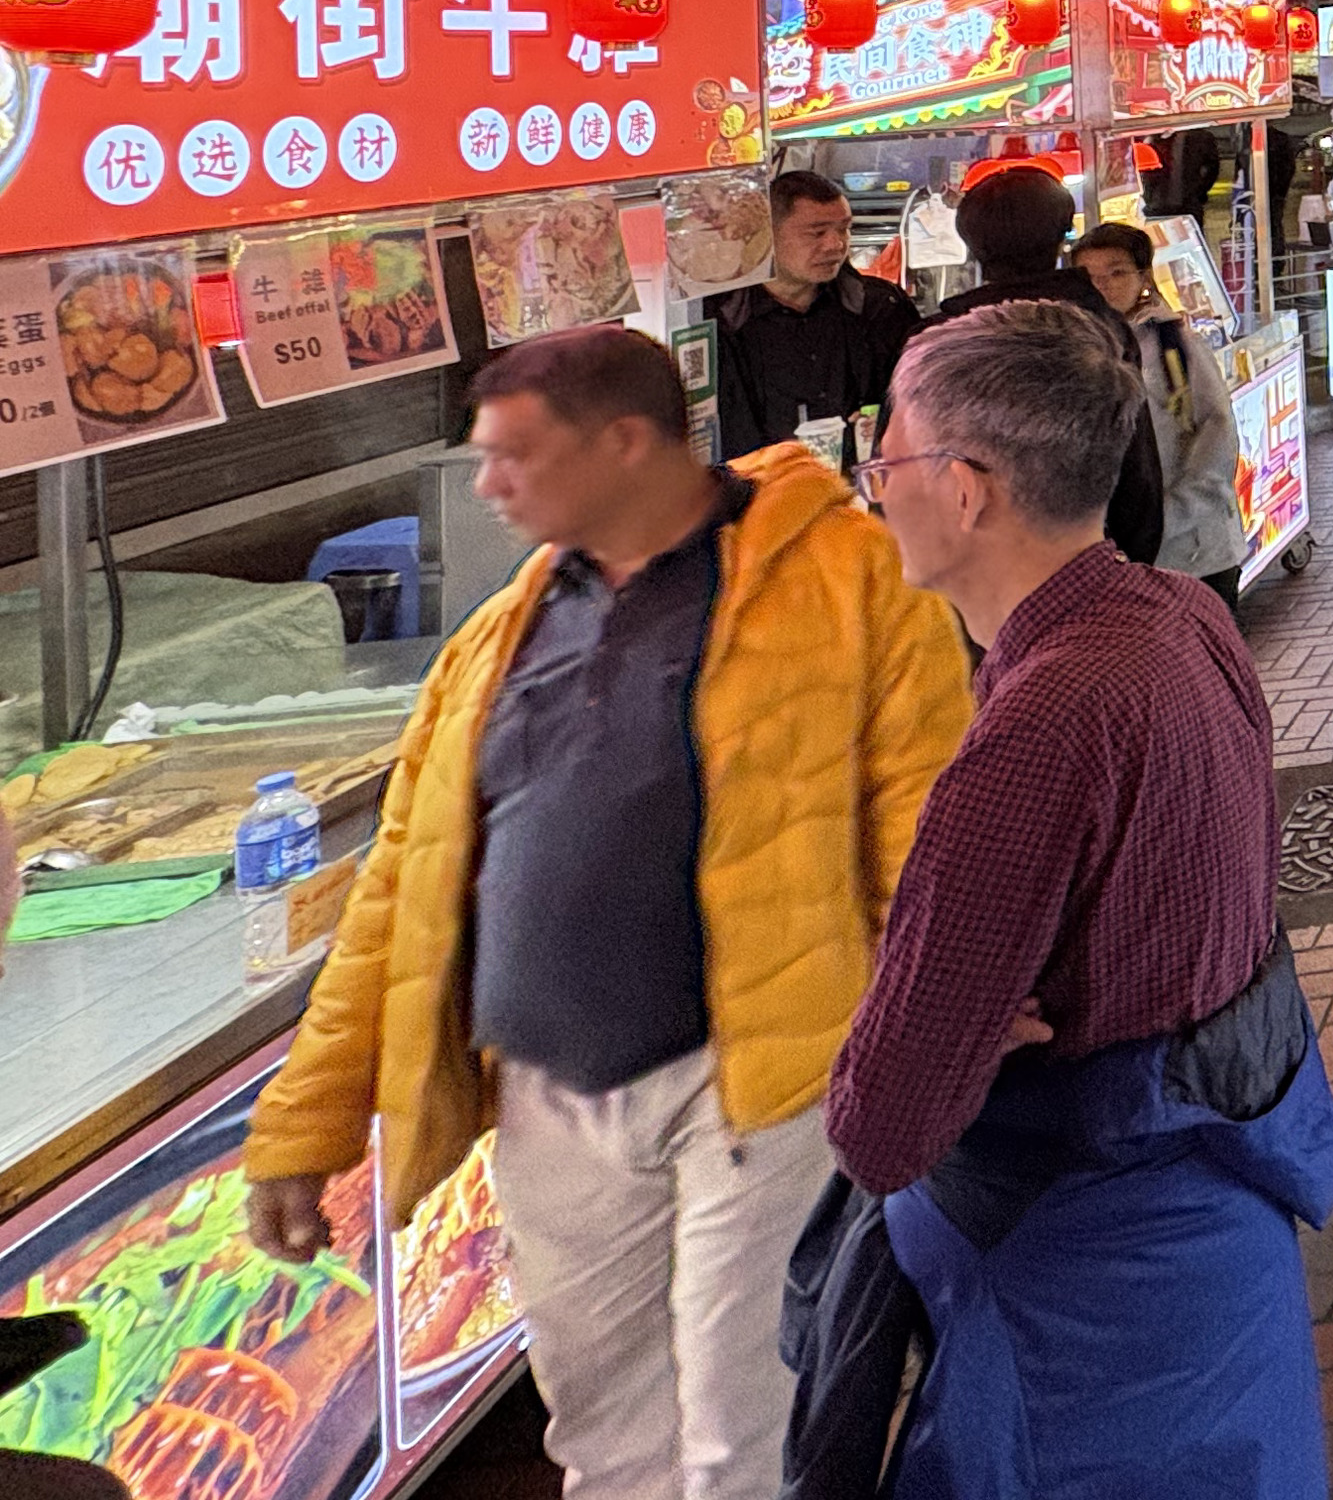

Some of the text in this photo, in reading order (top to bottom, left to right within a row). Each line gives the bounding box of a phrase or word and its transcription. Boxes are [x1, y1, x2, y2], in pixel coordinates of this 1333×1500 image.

[895, 0, 944, 27] Kong
[851, 66, 949, 100] Gourmet
[97, 122, 392, 194] 优选食材
[254, 299, 331, 325] Beef offal
